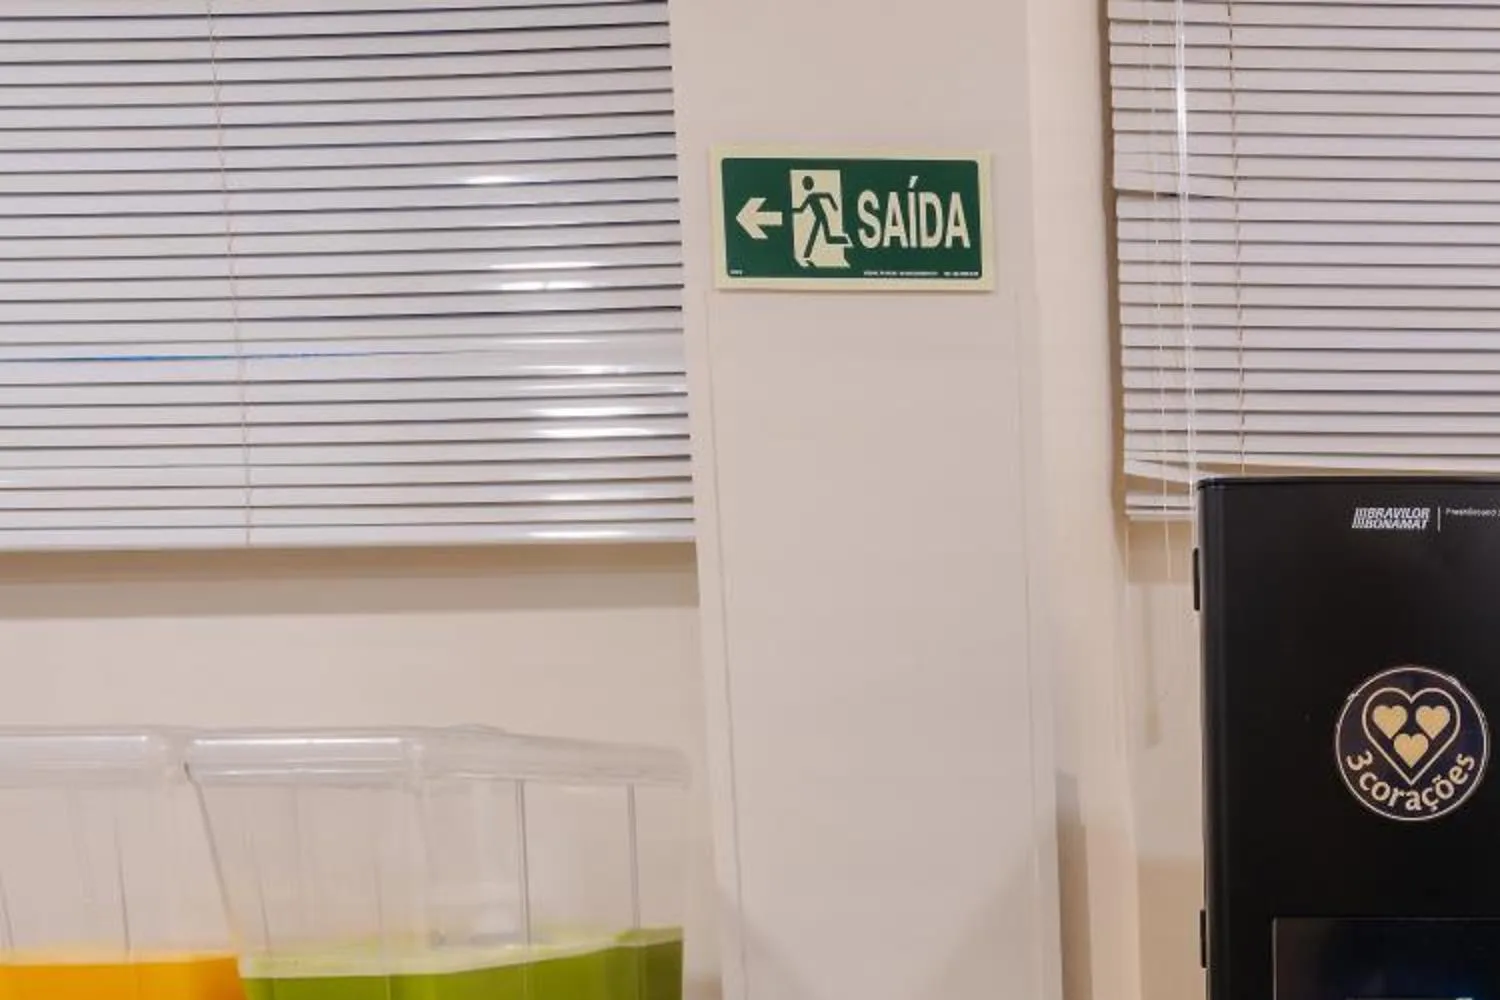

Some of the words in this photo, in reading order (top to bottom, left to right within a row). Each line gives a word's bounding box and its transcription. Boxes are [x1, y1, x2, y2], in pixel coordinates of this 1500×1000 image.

[857, 175, 971, 249] SAÍDA
[1367, 507, 1431, 518] BRAVILOR
[1364, 518, 1428, 529] BONAMAT
[1346, 750, 1374, 771] 3
[1358, 752, 1476, 812] corações
